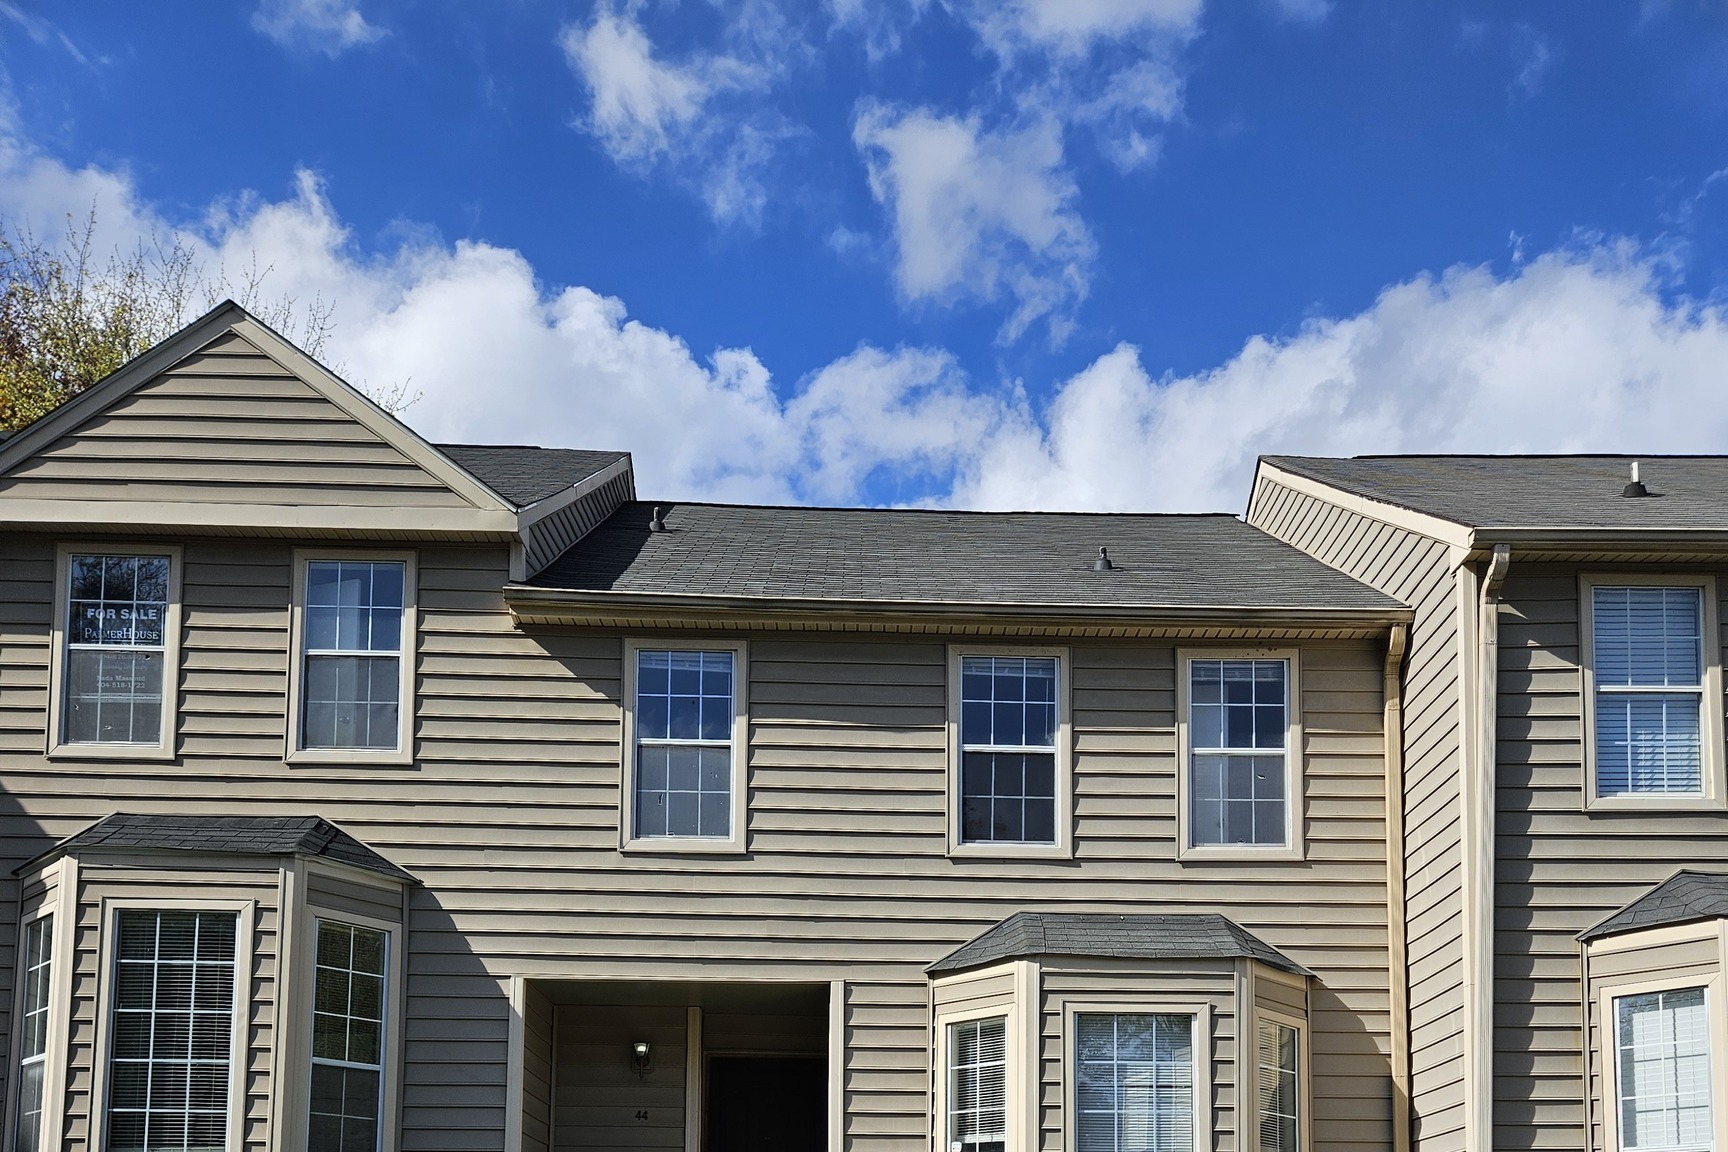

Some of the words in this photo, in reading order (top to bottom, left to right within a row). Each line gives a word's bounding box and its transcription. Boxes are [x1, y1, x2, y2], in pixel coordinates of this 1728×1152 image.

[86, 608, 116, 619] FOR
[120, 608, 157, 620] SALE
[634, 1110, 649, 1121] 44
